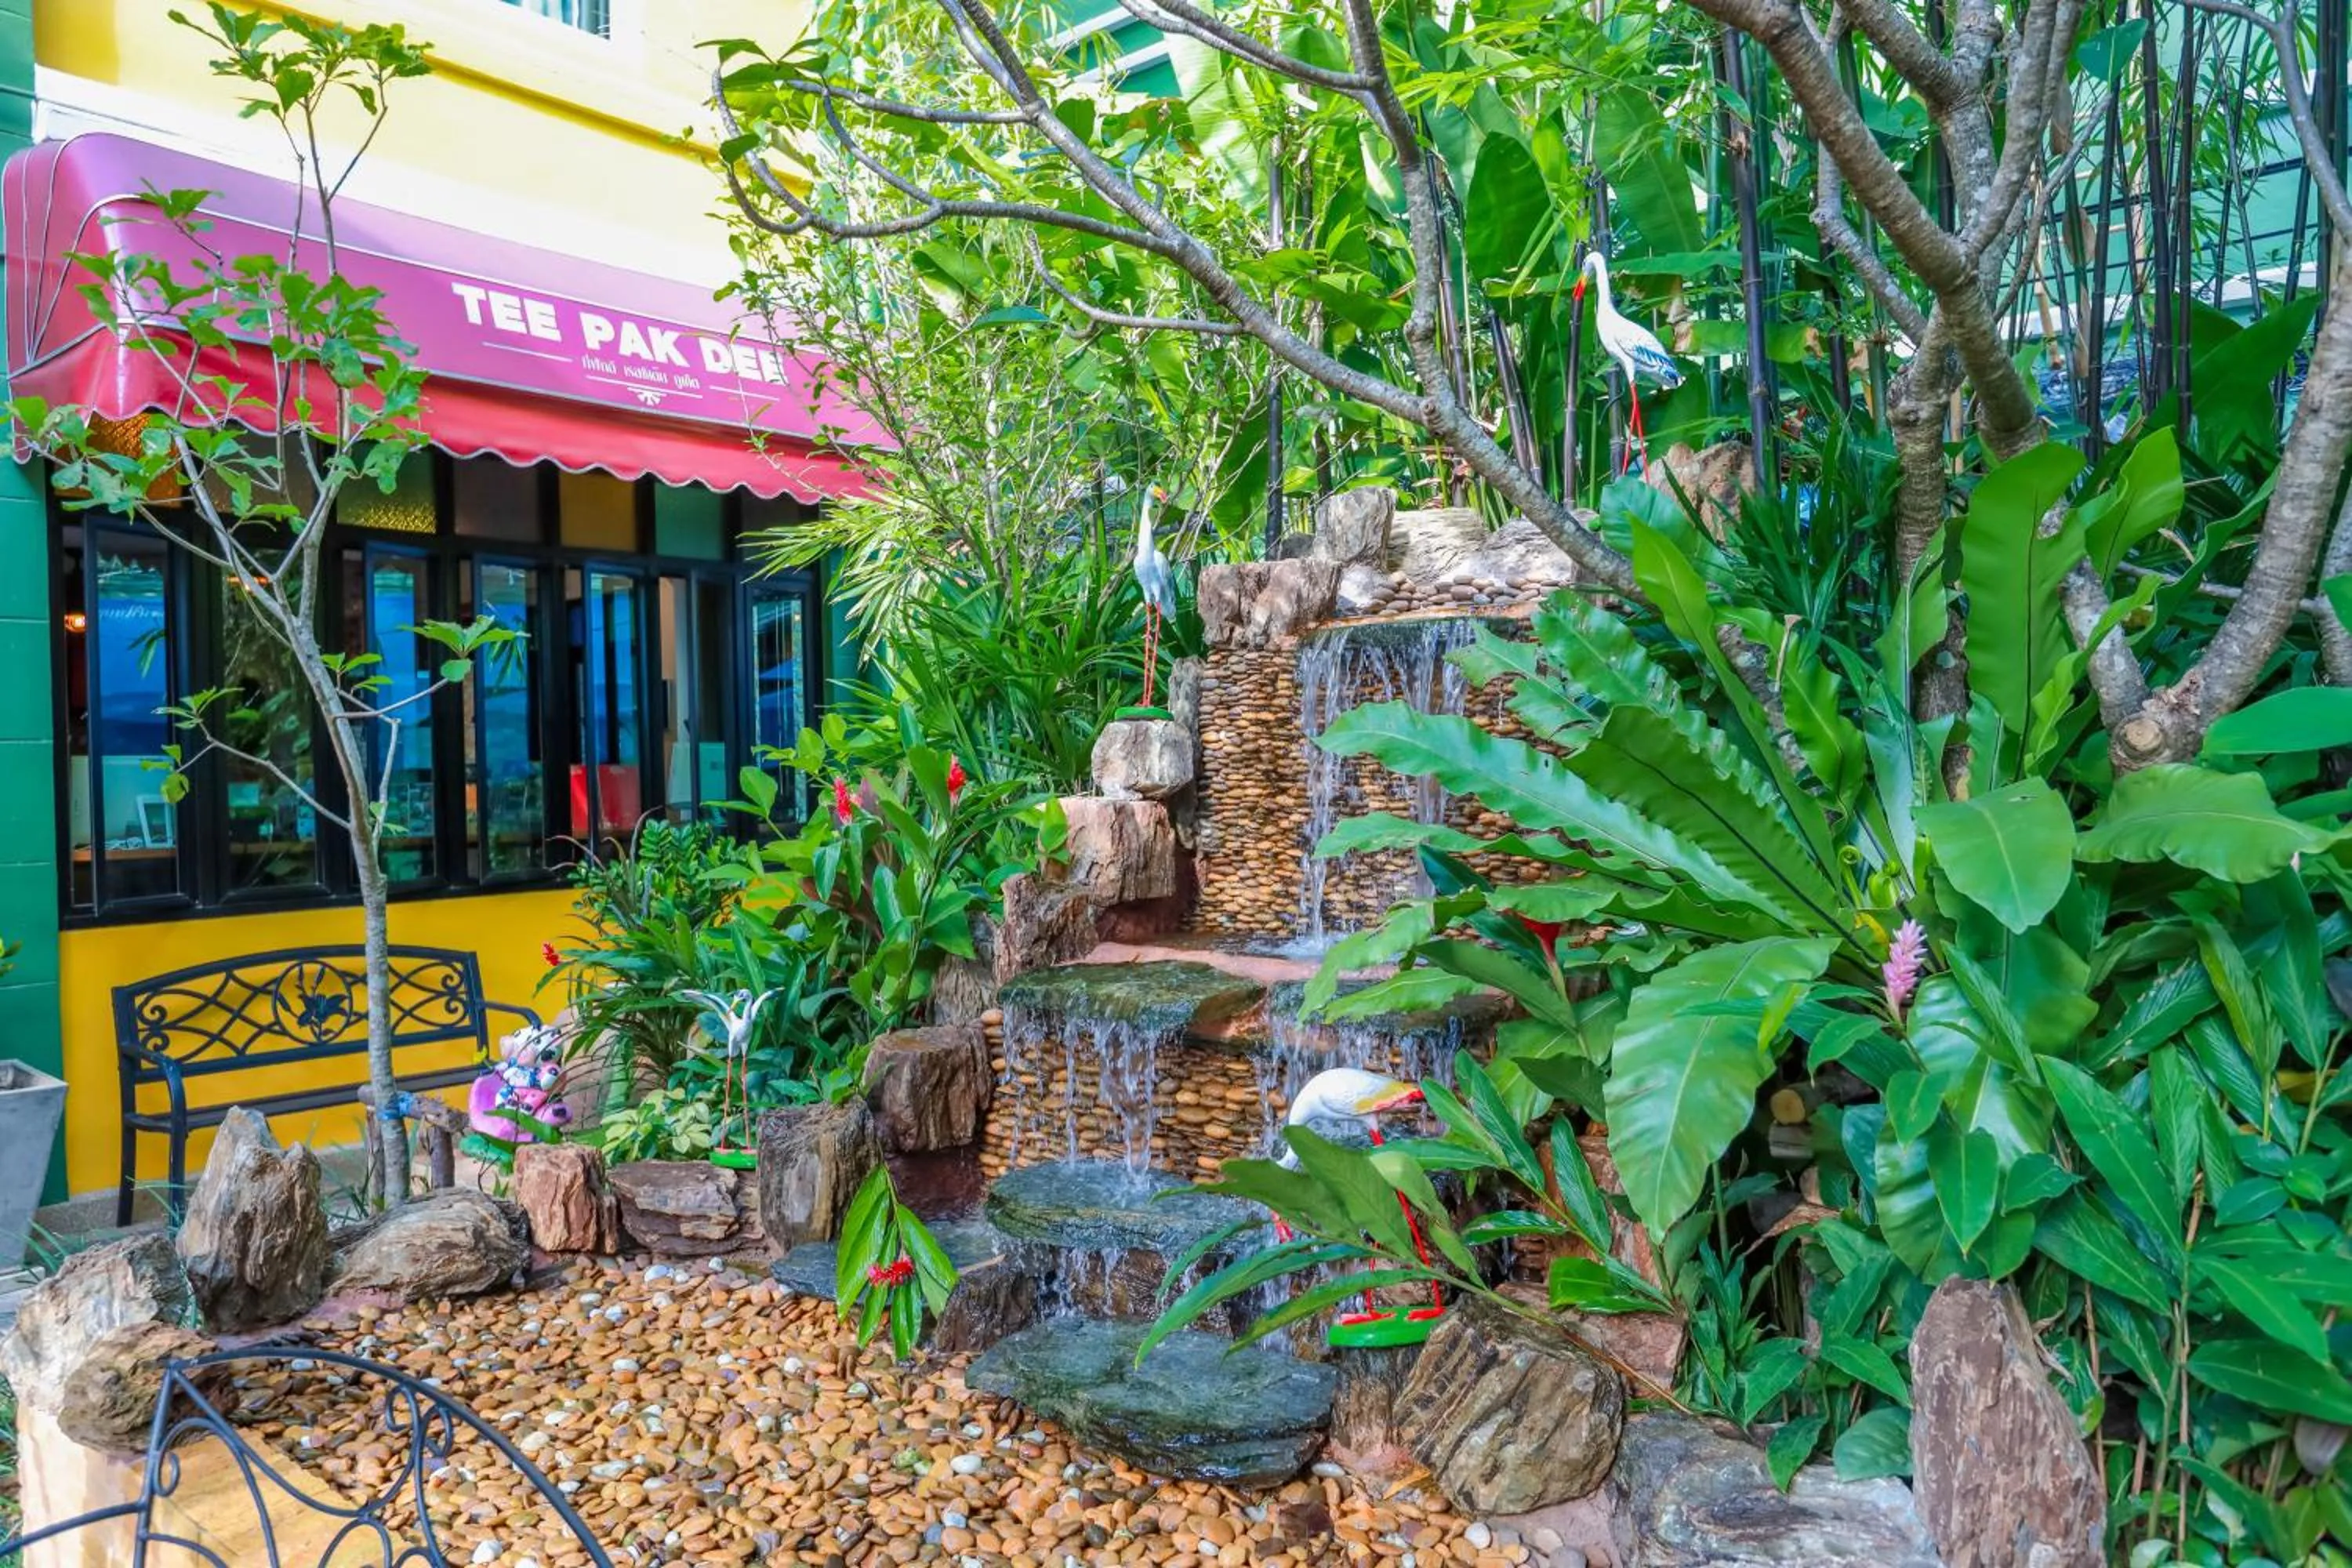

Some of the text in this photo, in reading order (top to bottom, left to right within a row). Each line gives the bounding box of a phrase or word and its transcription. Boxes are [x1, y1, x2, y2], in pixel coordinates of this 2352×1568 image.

[452, 281, 789, 387] TEE PAK DEE
